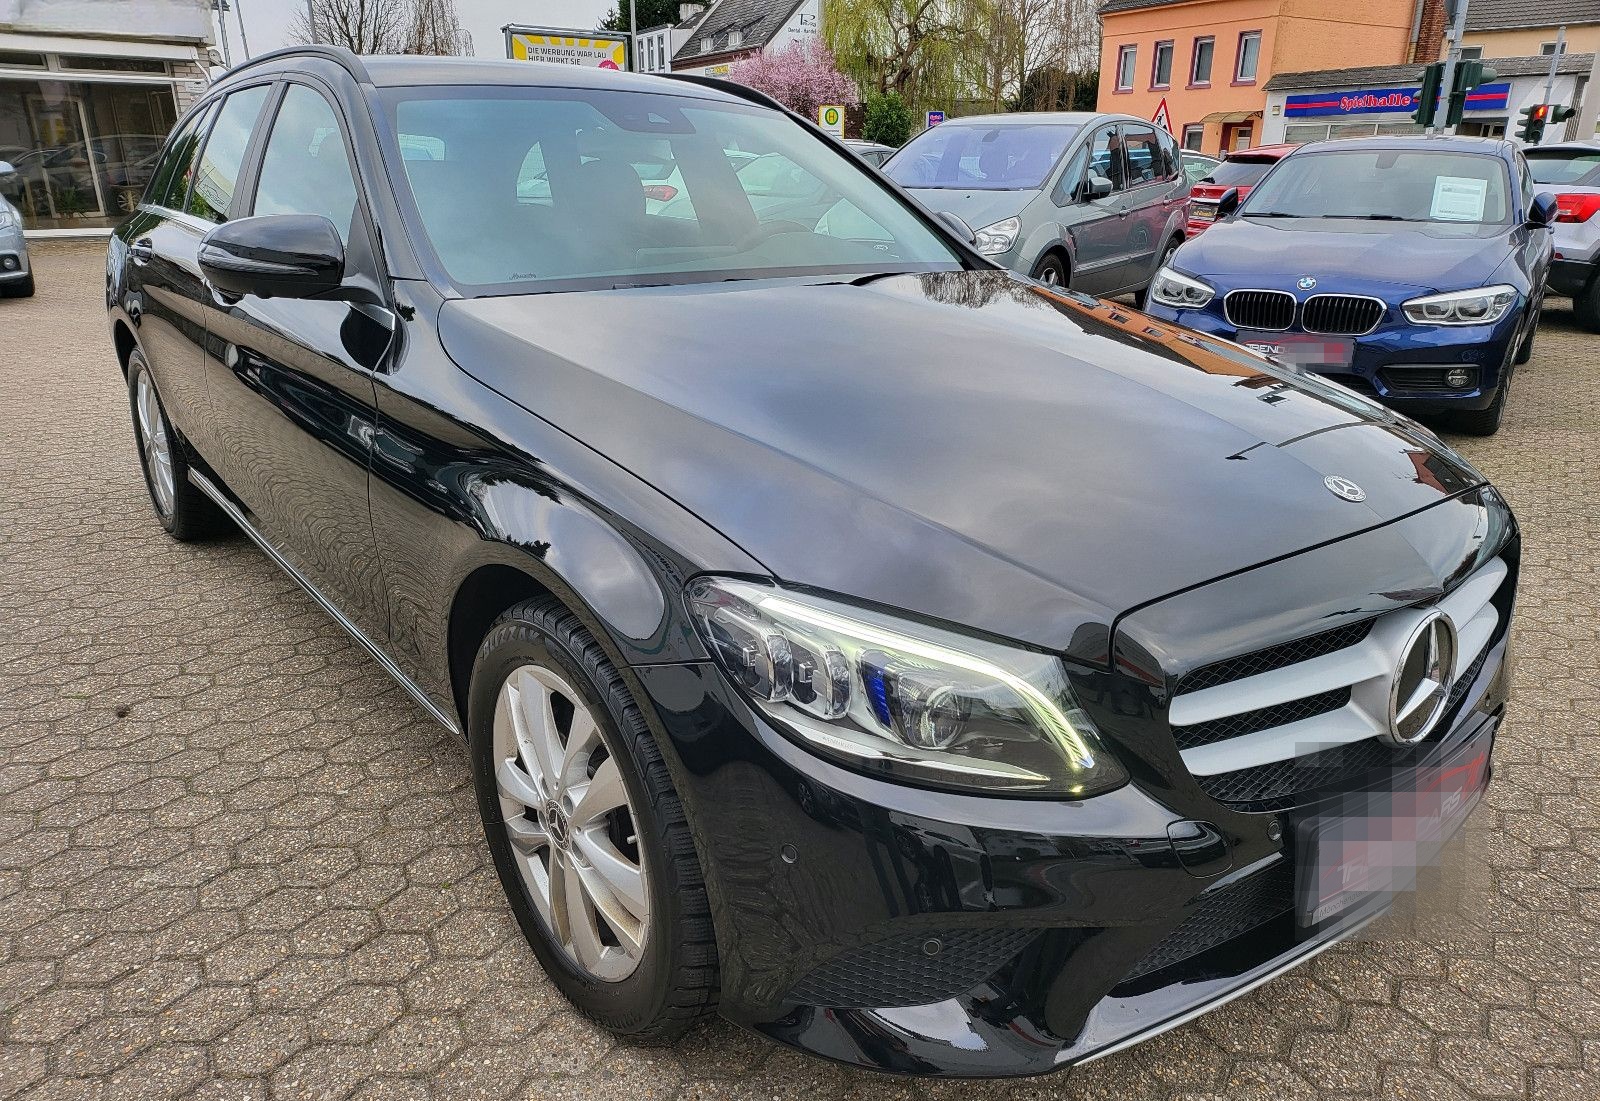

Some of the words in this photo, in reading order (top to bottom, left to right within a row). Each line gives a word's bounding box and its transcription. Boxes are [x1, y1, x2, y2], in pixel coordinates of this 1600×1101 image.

[540, 48, 575, 57] WERBUNG
[546, 56, 569, 65] WIRKT
[570, 58, 581, 66] SIE
[1341, 93, 1411, 112] Spielhalle
